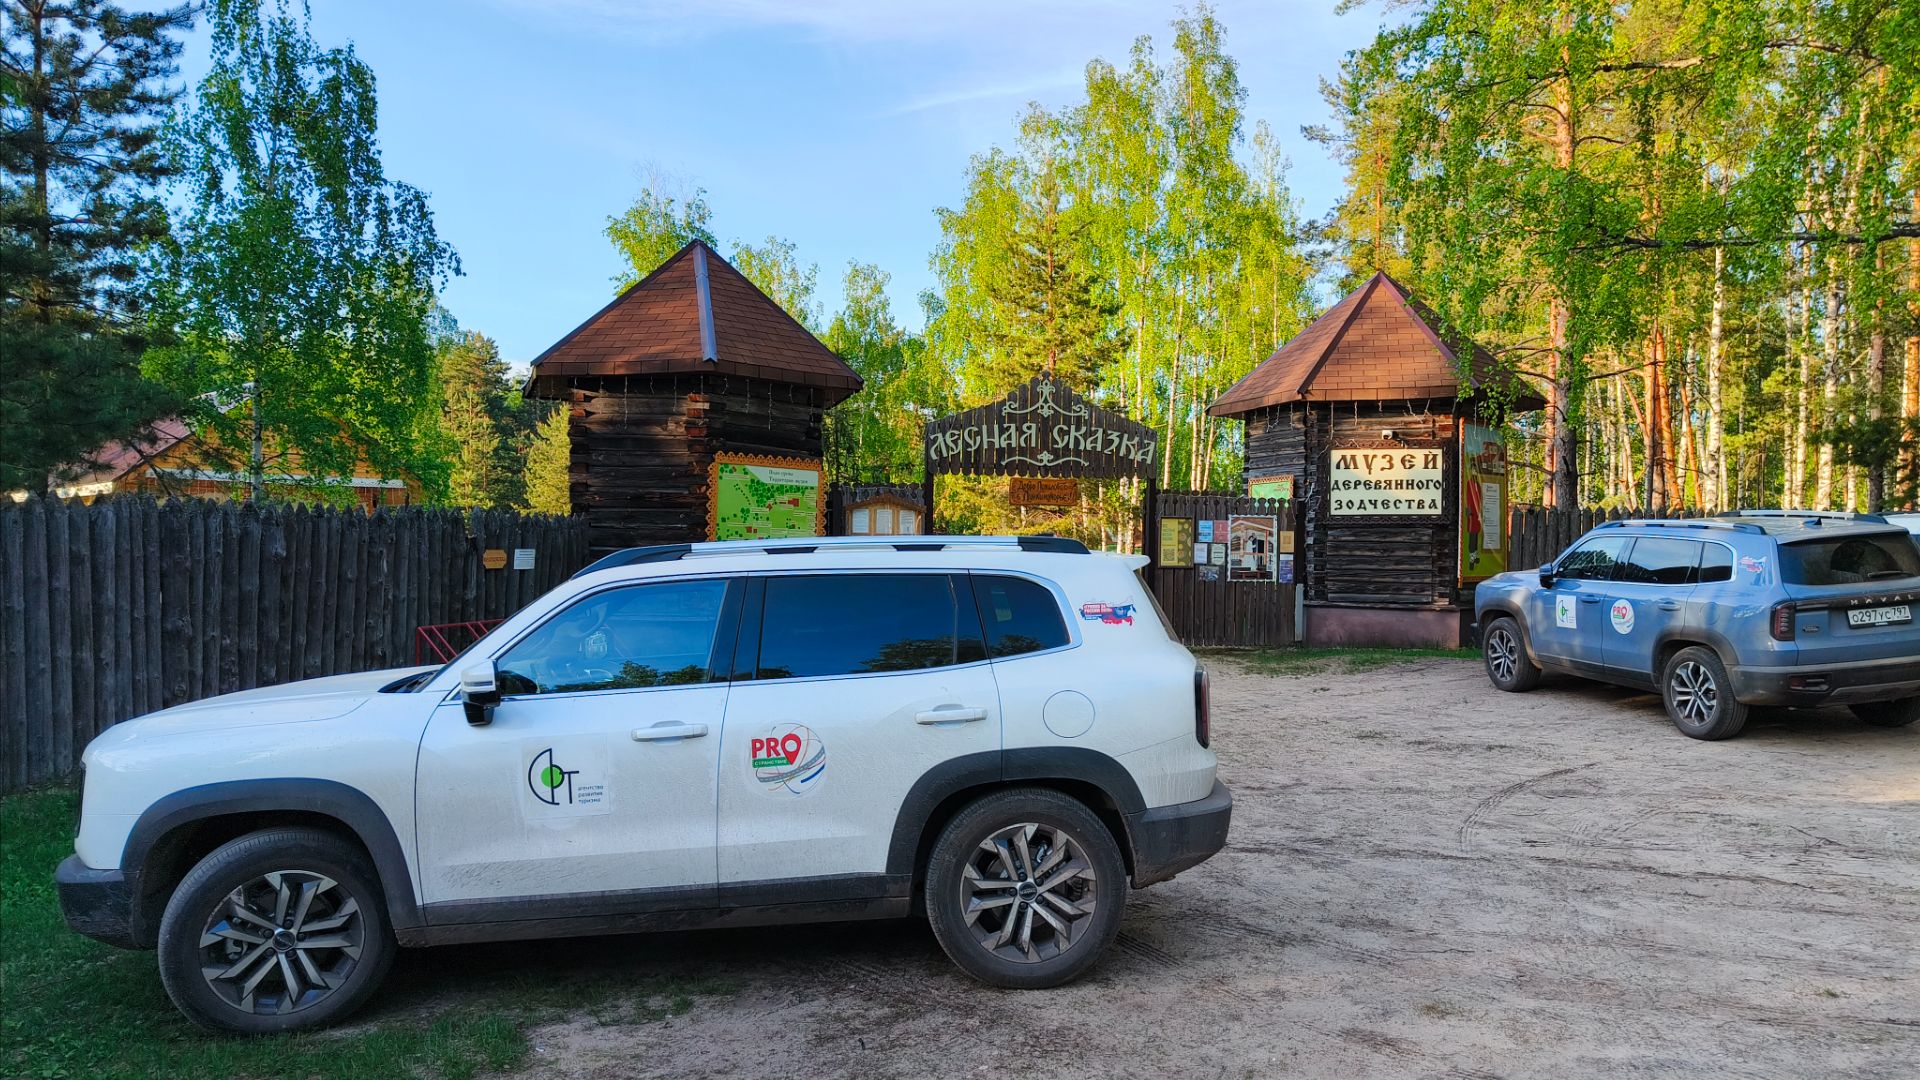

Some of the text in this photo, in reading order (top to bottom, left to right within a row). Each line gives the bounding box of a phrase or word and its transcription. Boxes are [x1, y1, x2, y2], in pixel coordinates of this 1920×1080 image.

[929, 422, 1156, 464] ЛЕСНАЯ СКАЗКА
[1335, 451, 1439, 475] МУЗЕЙ
[1331, 479, 1442, 492] ДЕРЕВЯННОГО
[1333, 498, 1439, 511] ЗОДЧЕСТВА
